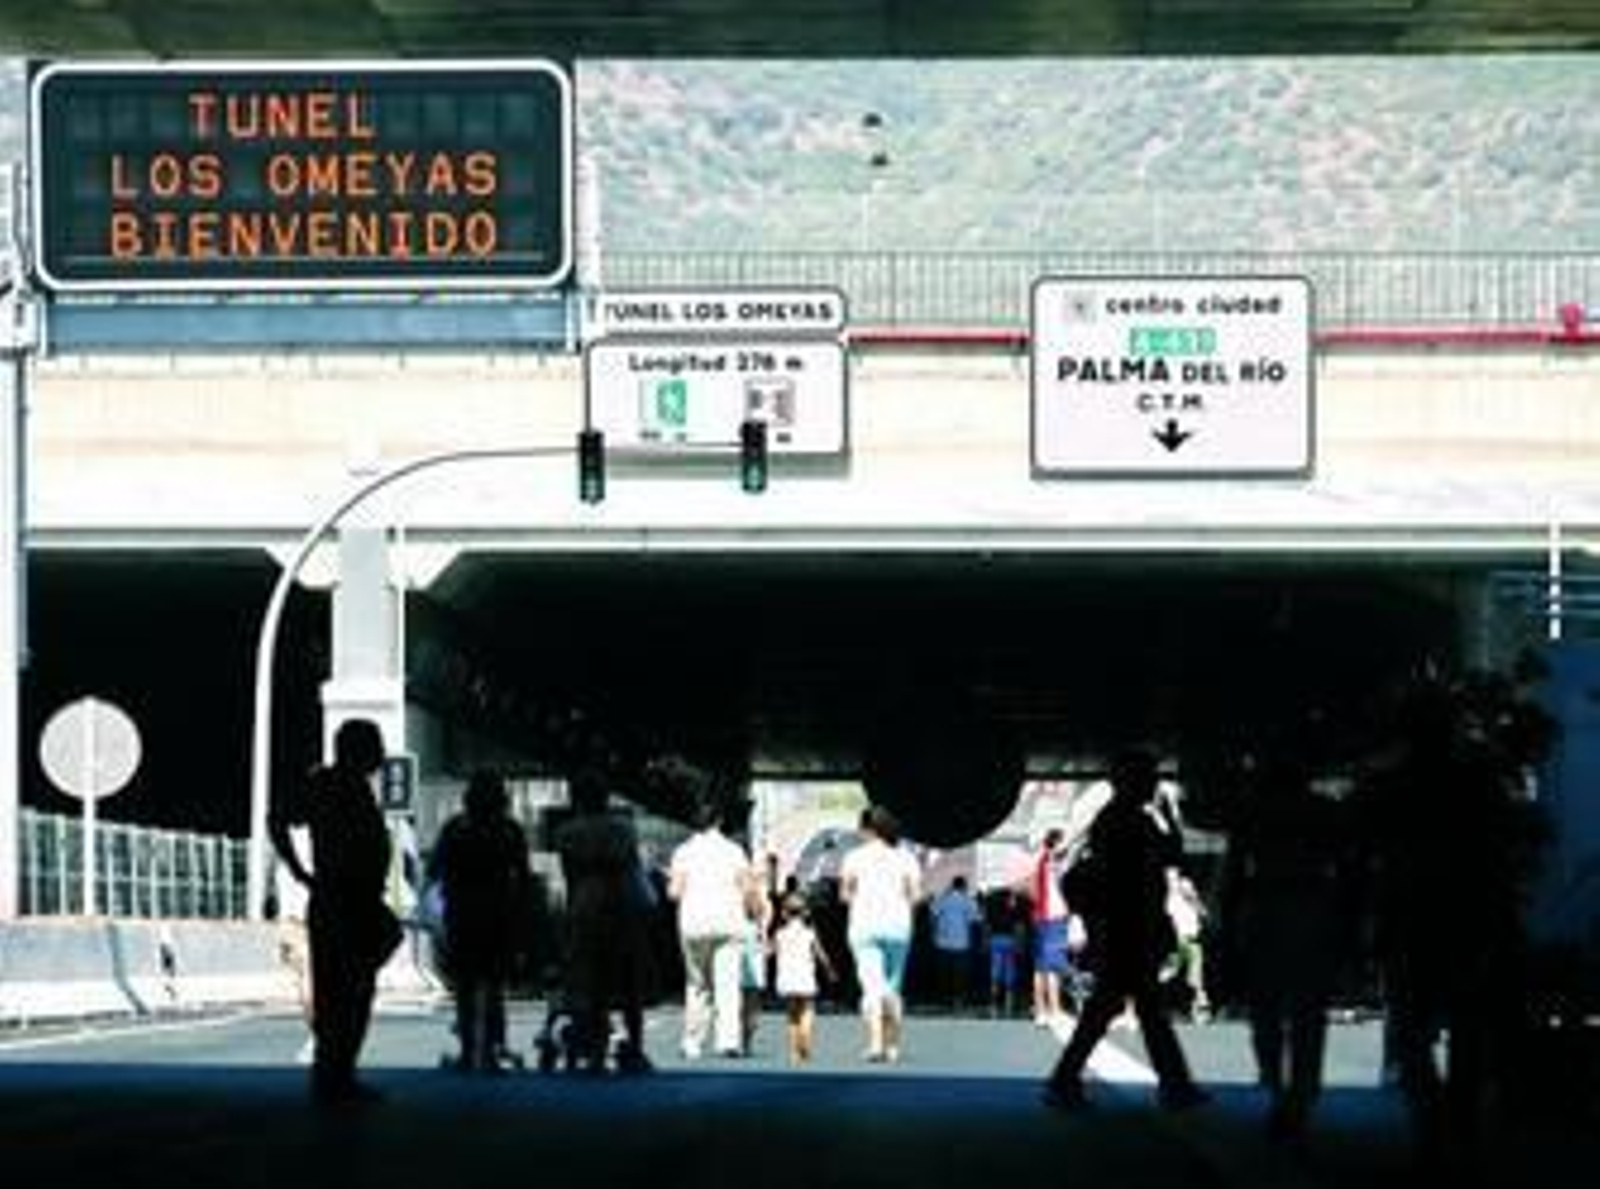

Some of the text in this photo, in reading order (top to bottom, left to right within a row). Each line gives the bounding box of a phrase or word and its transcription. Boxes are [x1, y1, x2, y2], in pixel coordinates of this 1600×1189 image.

[187, 93, 374, 138] TUNEL
[109, 153, 497, 197] LOS OMEYAS
[109, 211, 498, 256] BIENVENIDO
[681, 302, 729, 320] LOS
[737, 302, 834, 321] OMEYAS
[1106, 295, 1282, 314] centro ciudad
[1057, 357, 1169, 382] PALMA
[1182, 361, 1228, 382] DEL
